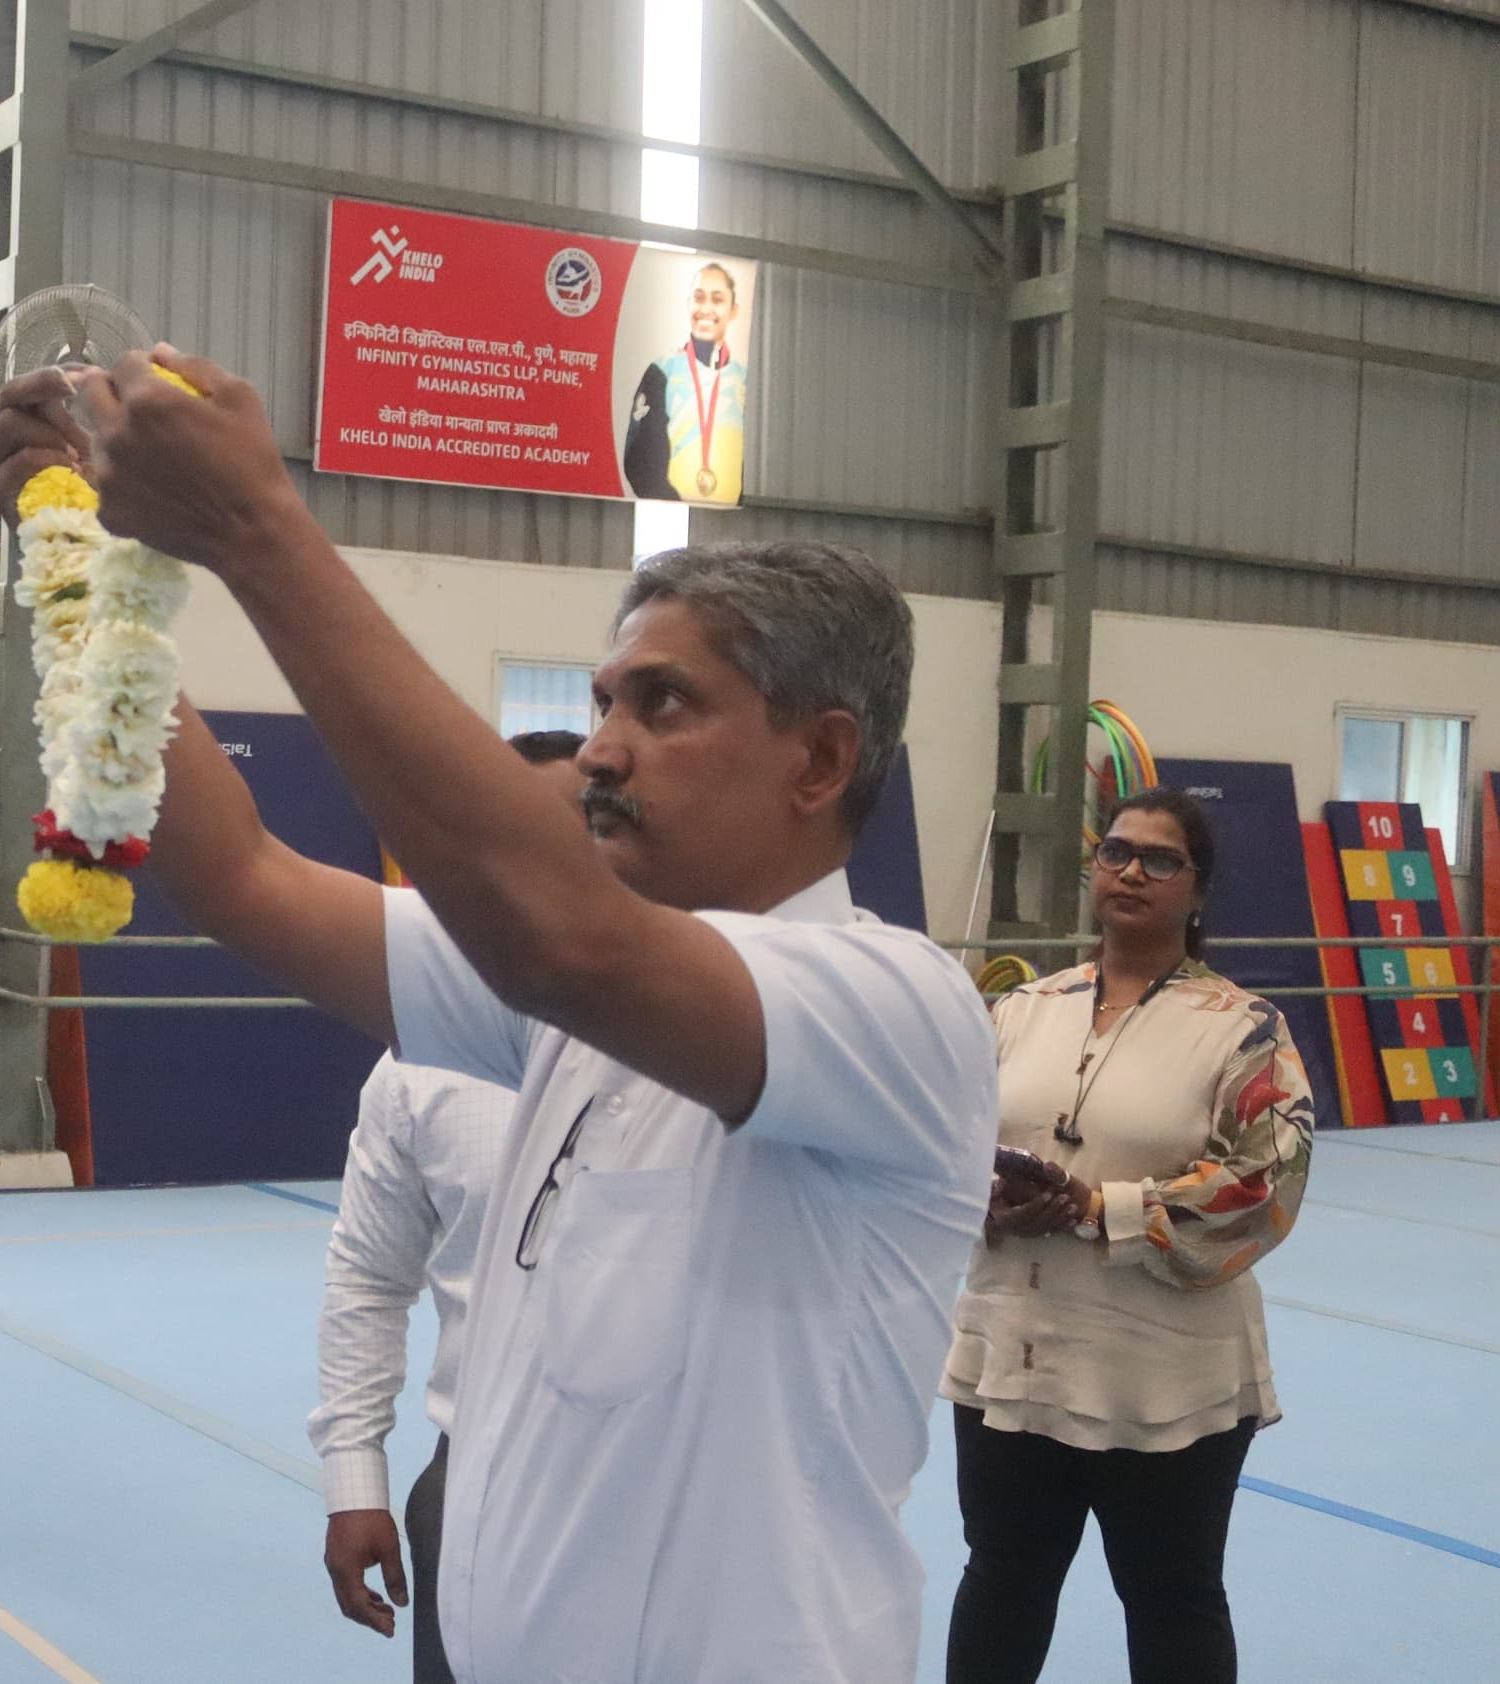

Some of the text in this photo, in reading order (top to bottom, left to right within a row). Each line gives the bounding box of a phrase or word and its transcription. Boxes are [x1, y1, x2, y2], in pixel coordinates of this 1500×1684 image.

[402, 249, 444, 269] KHELO
[399, 264, 436, 283] INDIA
[344, 320, 399, 343] इन्फिनिटी
[559, 349, 598, 372] महाराष्ट्र
[357, 346, 583, 388] INFINITY GYMNASTICS LLP, PUNE,
[417, 376, 526, 401] MAHARASHTRA
[379, 404, 558, 440] खेलो इंडिया मान्यता प्राप्त अकादमी
[340, 427, 590, 465] KHELO INDIA ACCREDITED ACADEMY
[218, 743, 253, 757] TaiS
[1368, 815, 1393, 838] 10
[1362, 864, 1416, 887] 8 9
[1390, 913, 1404, 936] 7
[1382, 961, 1438, 985] 5 6
[1412, 1011, 1427, 1033] 4
[1403, 1059, 1458, 1086] 2 3
